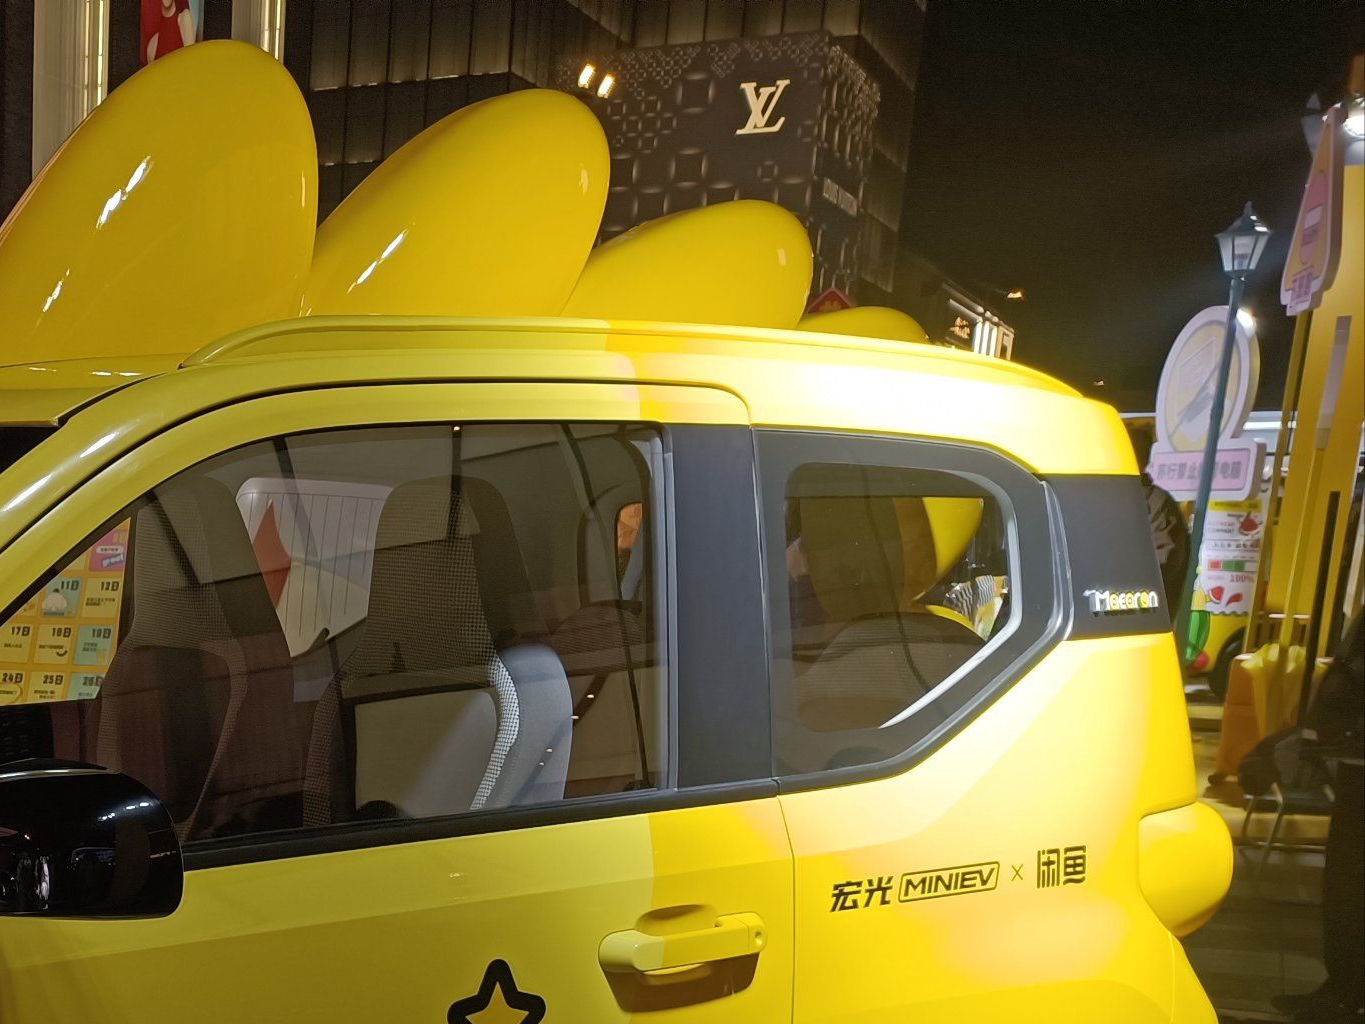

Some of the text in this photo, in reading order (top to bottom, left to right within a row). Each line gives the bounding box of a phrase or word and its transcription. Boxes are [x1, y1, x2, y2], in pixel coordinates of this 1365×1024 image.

[830, 875, 894, 913] 宏光
[901, 863, 997, 901] MINIEV
[1037, 845, 1087, 889] 闲鱼
